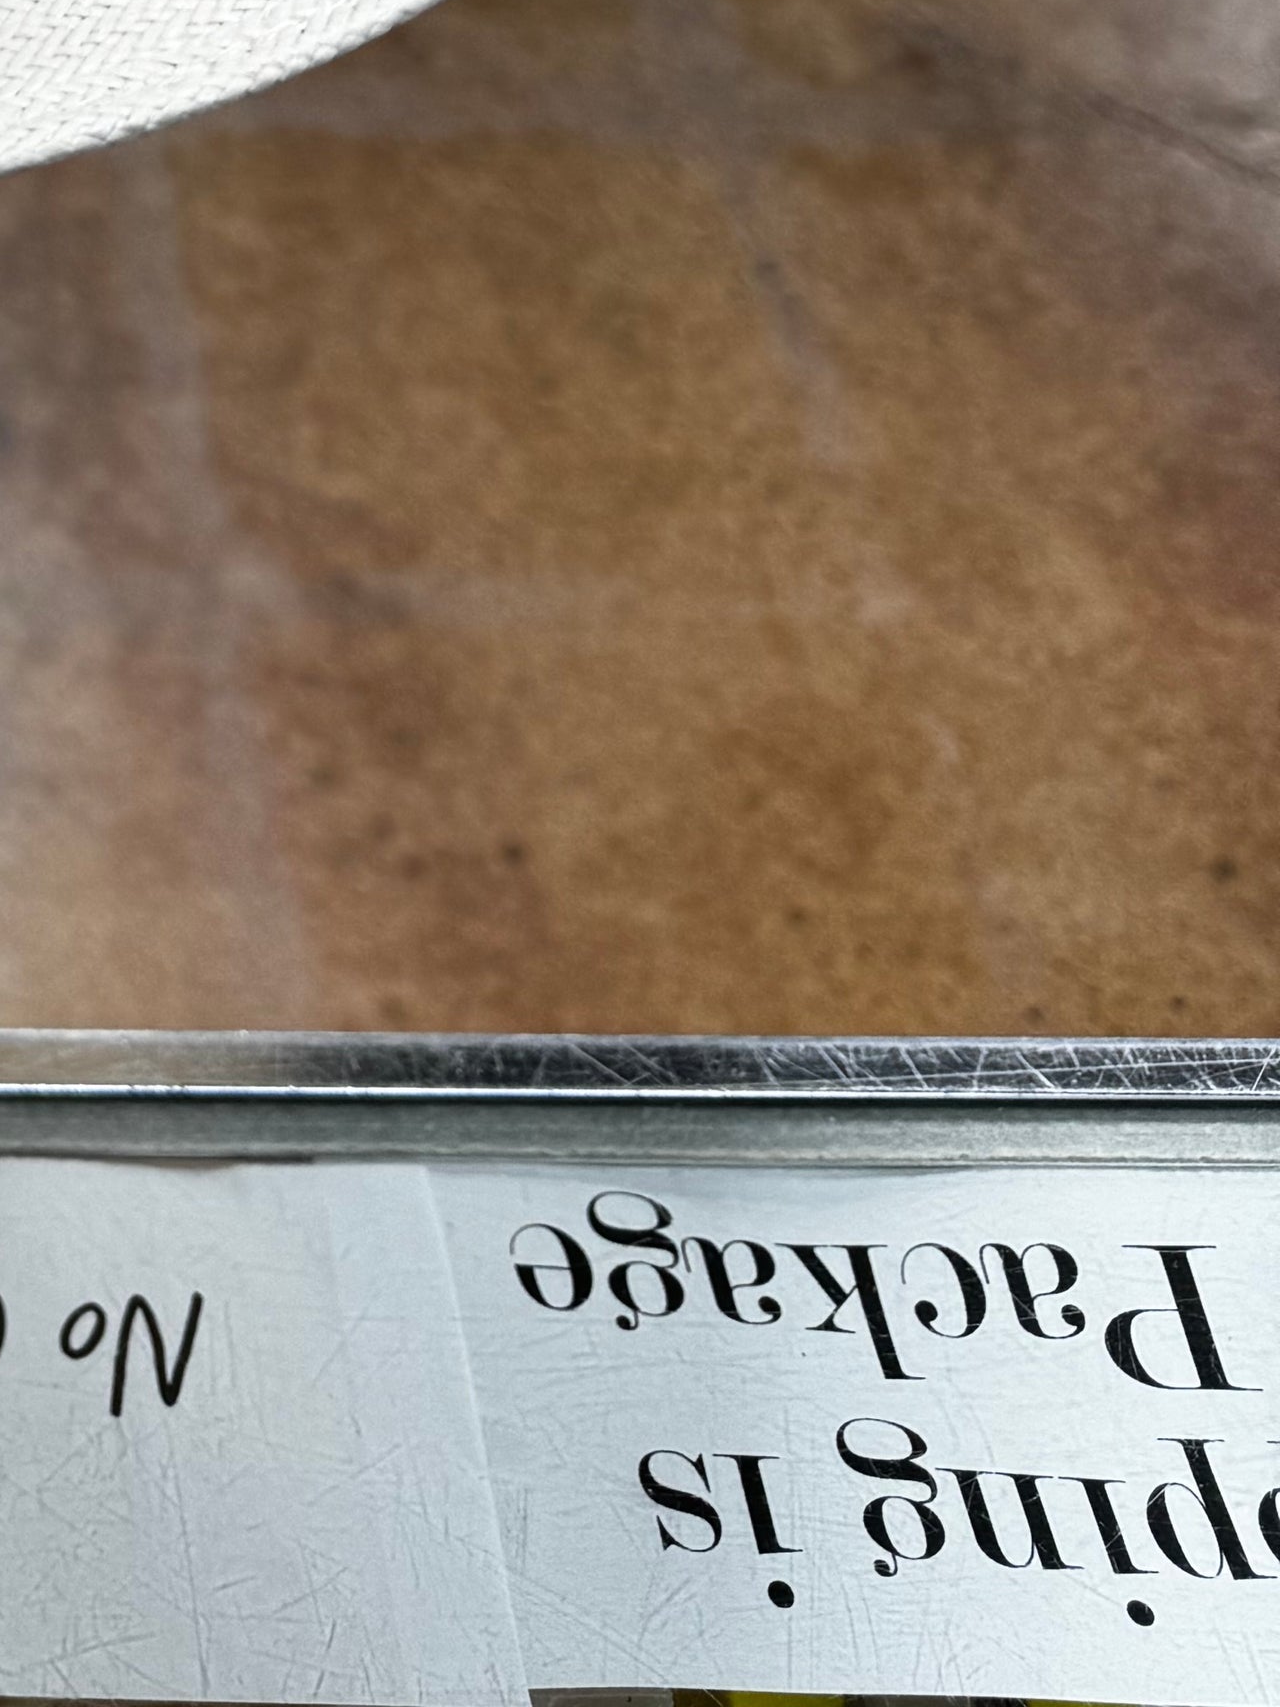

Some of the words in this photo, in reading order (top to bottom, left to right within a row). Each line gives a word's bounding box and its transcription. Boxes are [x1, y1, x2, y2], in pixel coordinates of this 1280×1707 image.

[58, 1291, 204, 1419] No
[514, 1194, 1262, 1392] Package
[635, 1448, 806, 1610] is
[832, 1416, 1280, 1629] ping
